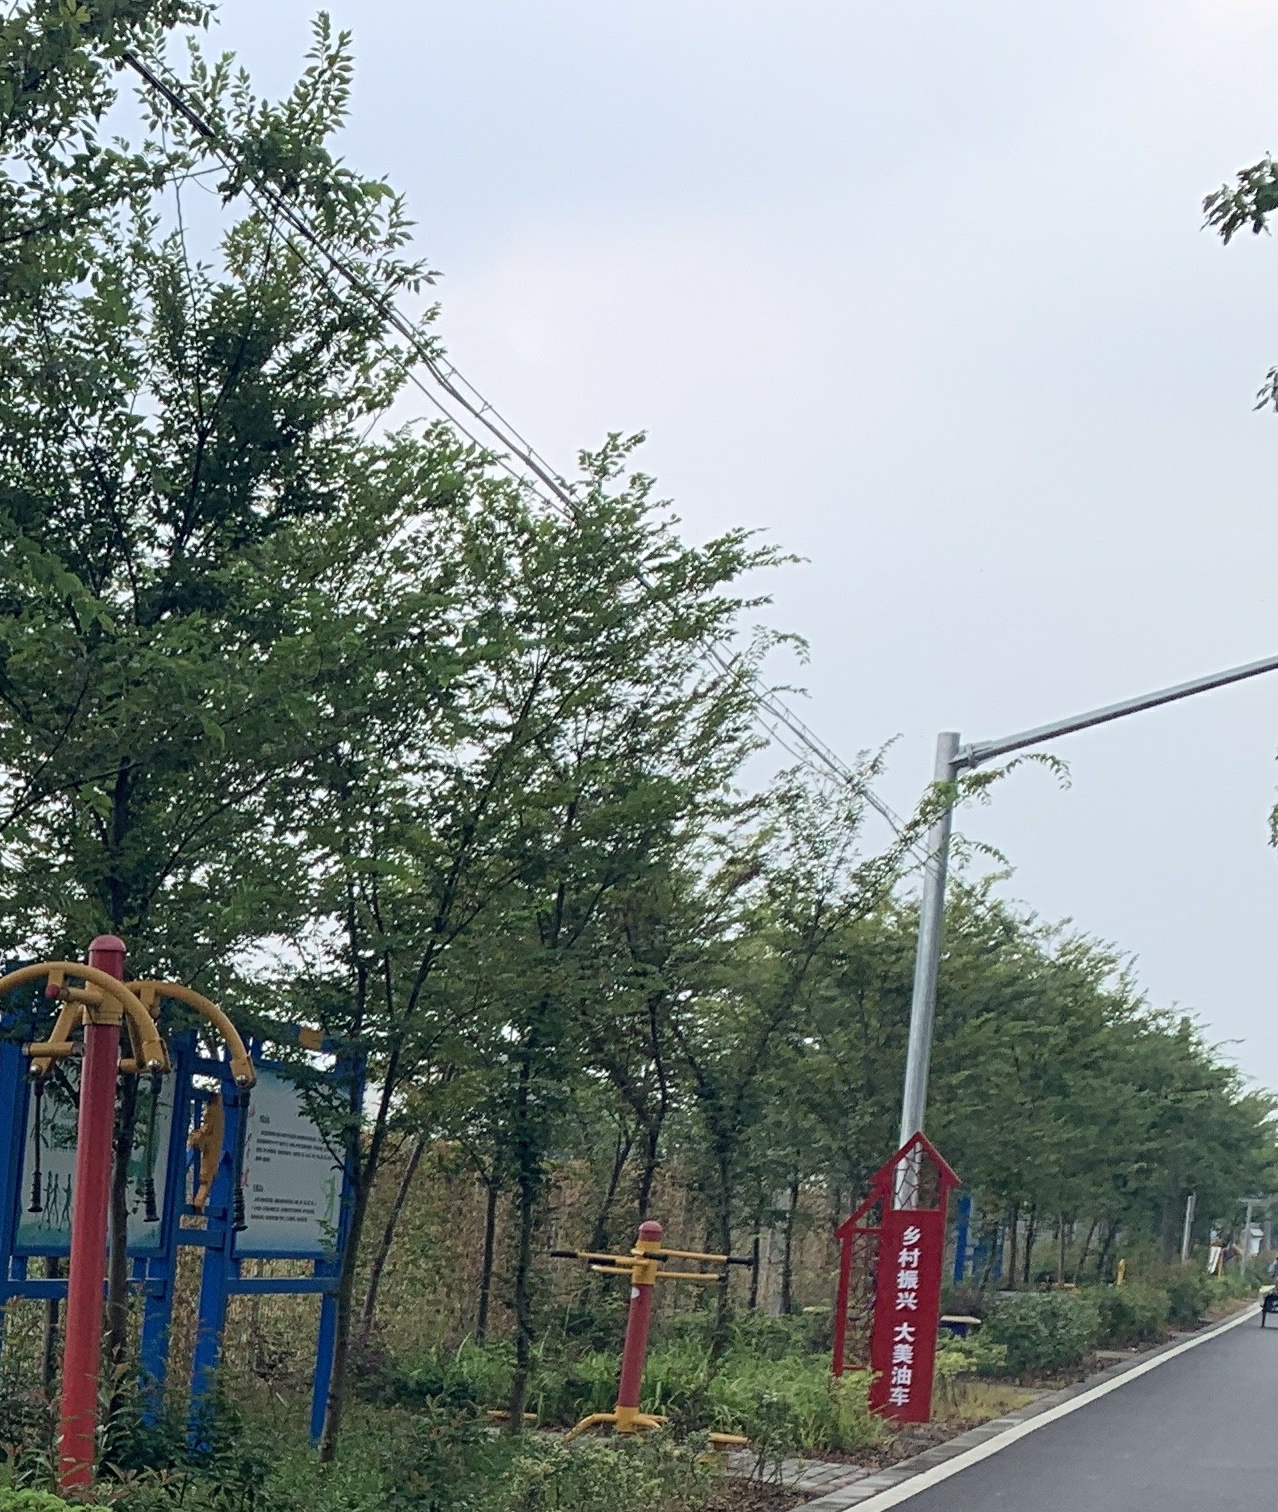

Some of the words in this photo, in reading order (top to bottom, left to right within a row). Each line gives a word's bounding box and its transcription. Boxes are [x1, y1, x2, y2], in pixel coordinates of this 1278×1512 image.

[895, 1225, 922, 1311] 乡村振兴
[889, 1322, 916, 1406] 大美油车
